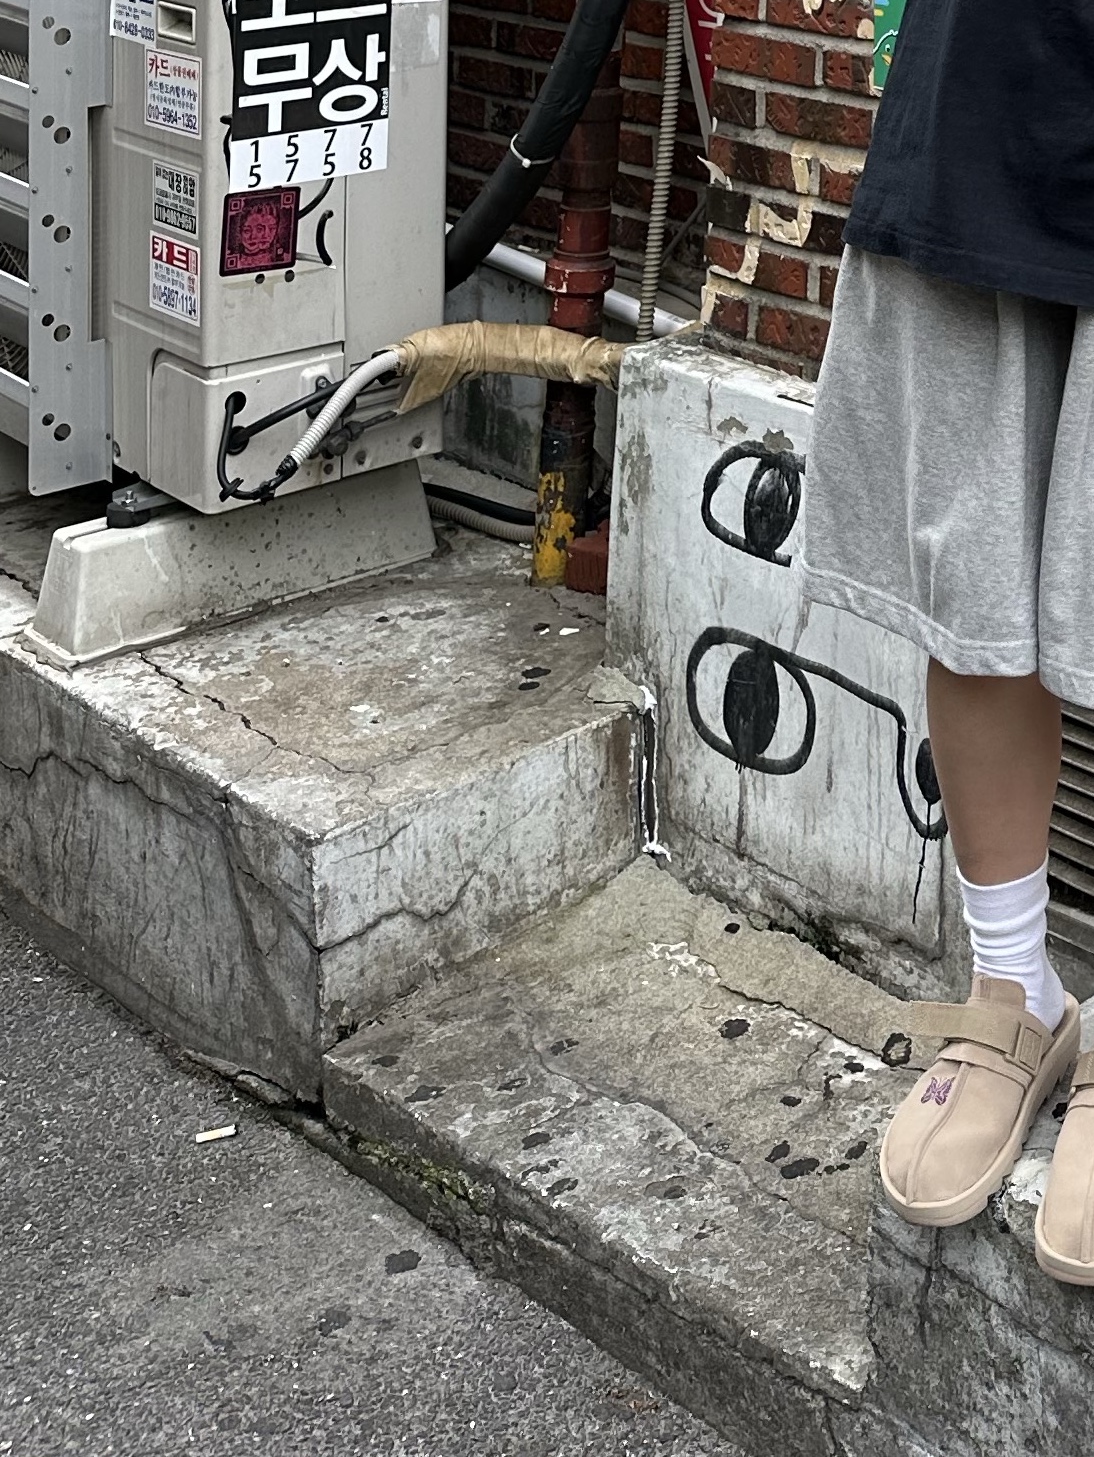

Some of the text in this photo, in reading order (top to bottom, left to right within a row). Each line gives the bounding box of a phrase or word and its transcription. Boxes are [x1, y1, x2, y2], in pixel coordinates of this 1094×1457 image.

[149, 54, 171, 78] 카드
[237, 33, 388, 133] 무상
[153, 237, 187, 269] 카드
